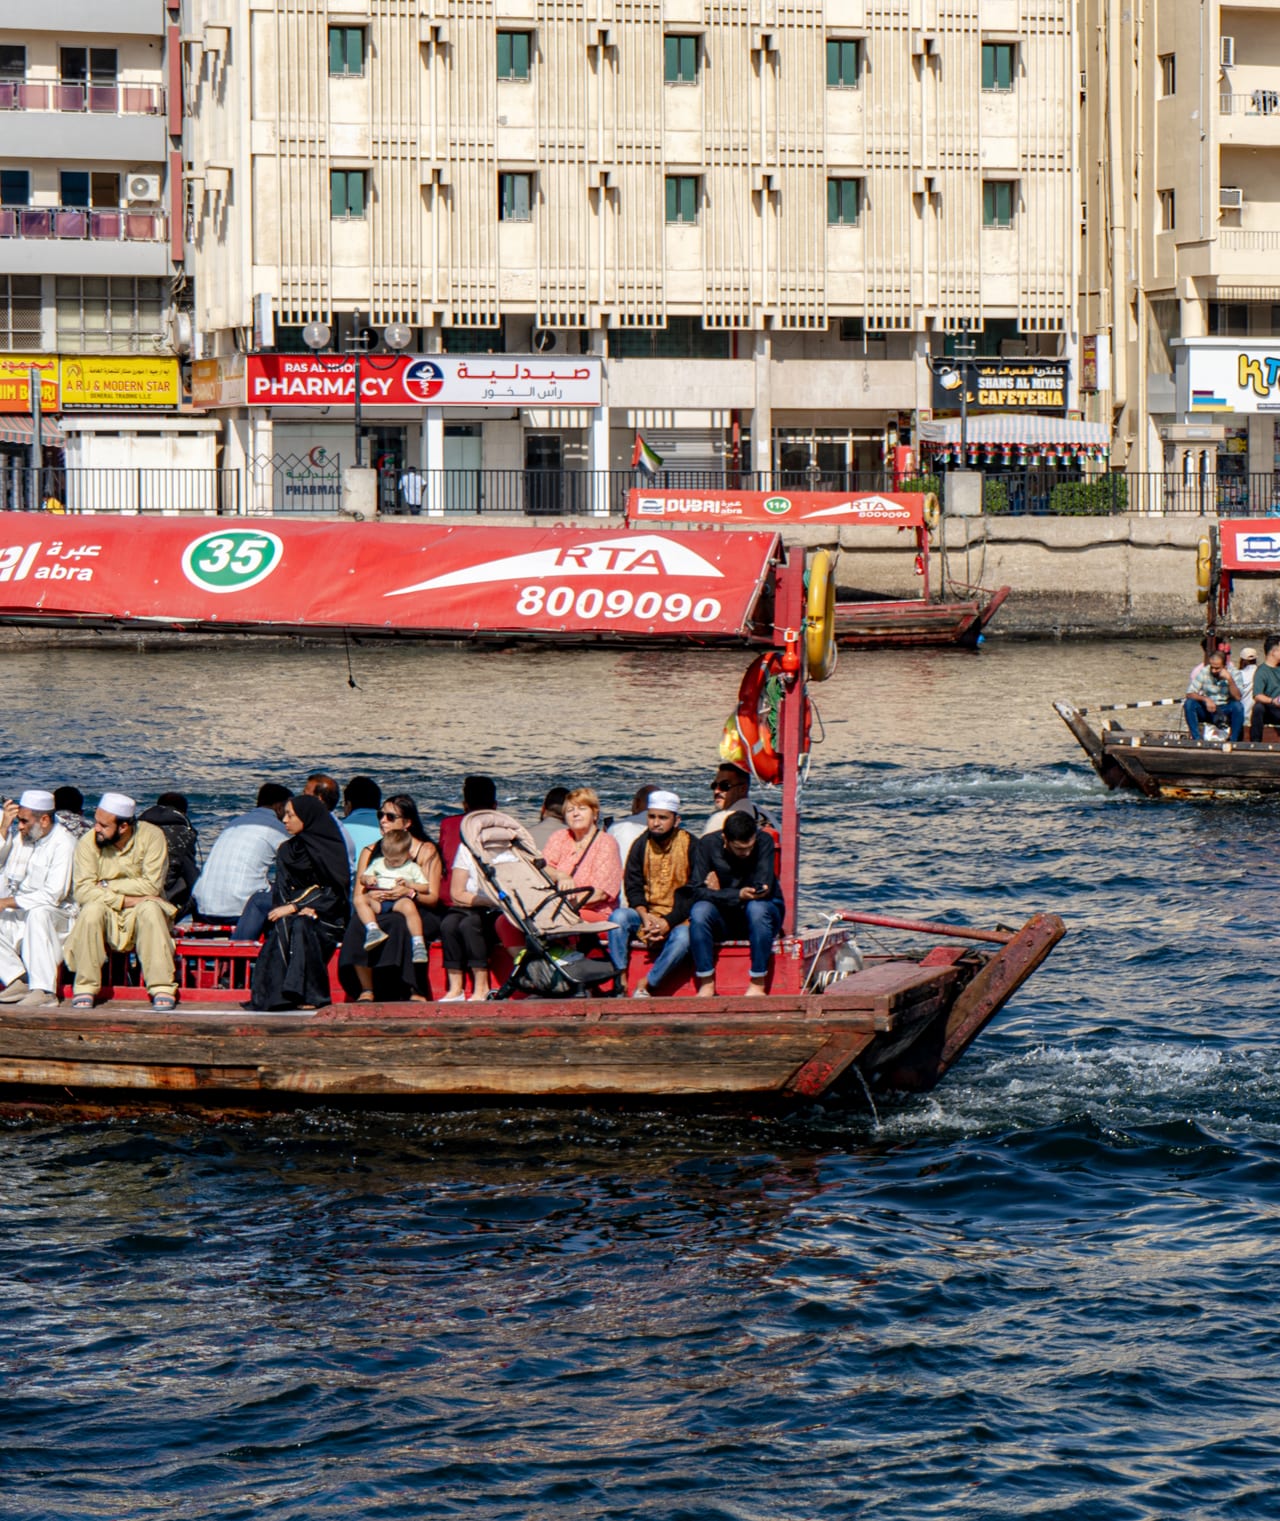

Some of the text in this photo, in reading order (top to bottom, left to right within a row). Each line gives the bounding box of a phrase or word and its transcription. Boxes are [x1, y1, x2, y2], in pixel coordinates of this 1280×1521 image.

[285, 363, 357, 373] RAS AL KHO
[457, 362, 590, 384] صيدلية
[94, 381, 100, 391] &
[104, 381, 143, 391] MODERN
[146, 381, 170, 391] STAR
[255, 377, 393, 396] PHARMACY
[978, 377, 1014, 389] SHAMS
[1016, 377, 1030, 389] AL
[482, 386, 535, 399] الخور
[978, 390, 1064, 405] CAFETERIA
[667, 498, 720, 514] DUBAI
[768, 501, 787, 509] 114
[850, 502, 887, 511] RTA
[47, 541, 102, 560] عبرة
[198, 538, 268, 574] 35
[554, 547, 668, 576] RTA
[34, 564, 94, 582] abra
[516, 586, 721, 623] 8009090
